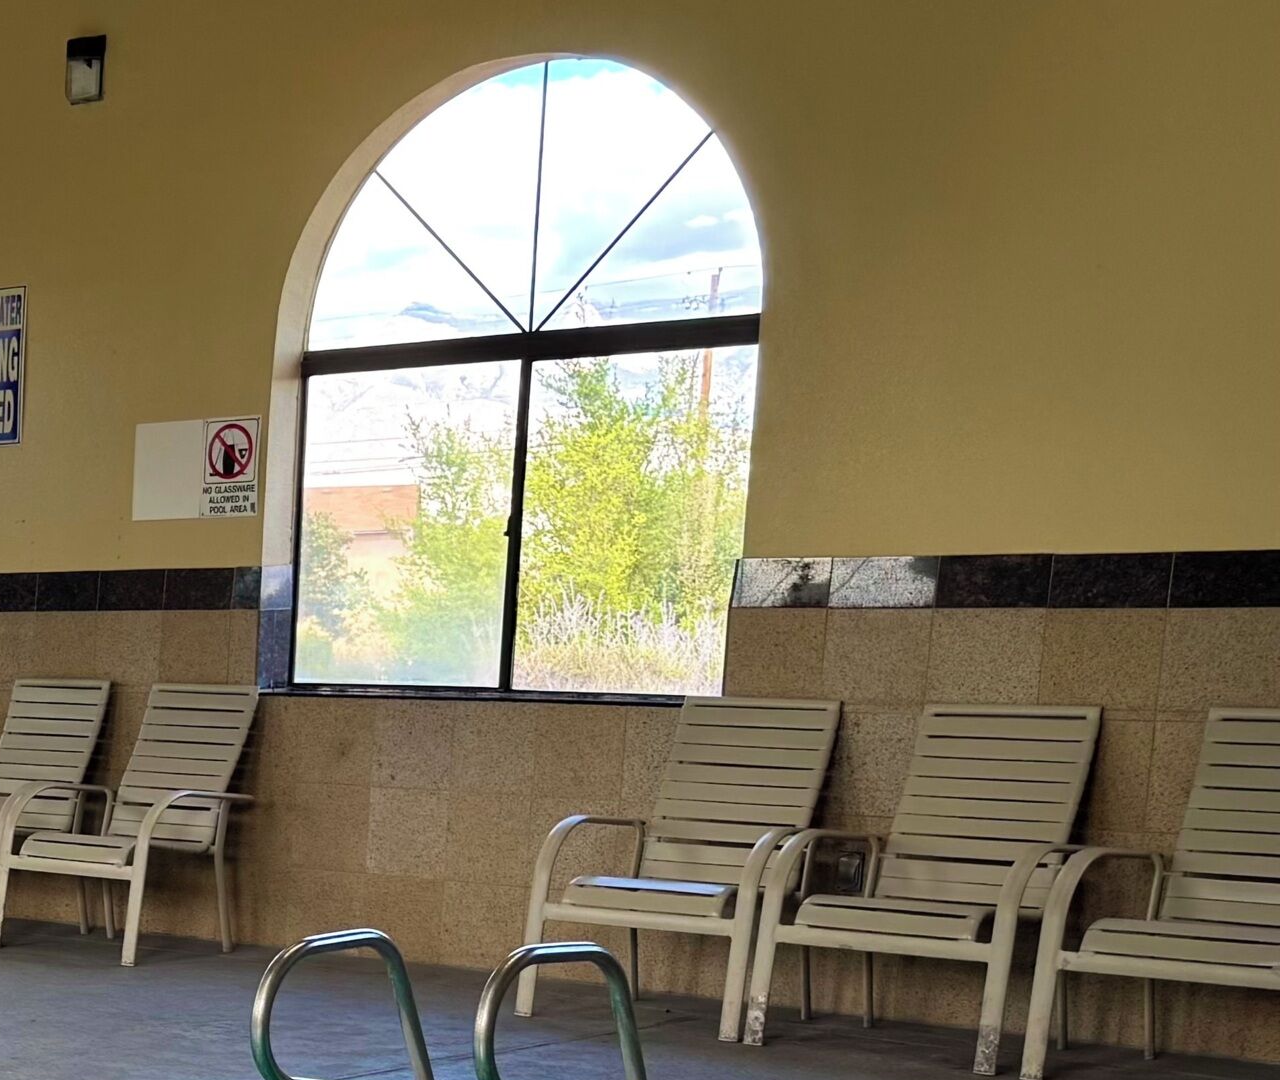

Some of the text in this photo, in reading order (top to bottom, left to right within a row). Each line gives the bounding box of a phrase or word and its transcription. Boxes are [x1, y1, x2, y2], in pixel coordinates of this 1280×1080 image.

[203, 484, 255, 494] NO GLASSWARE
[209, 495, 240, 504] ALLOWED
[230, 504, 248, 513] AREA
